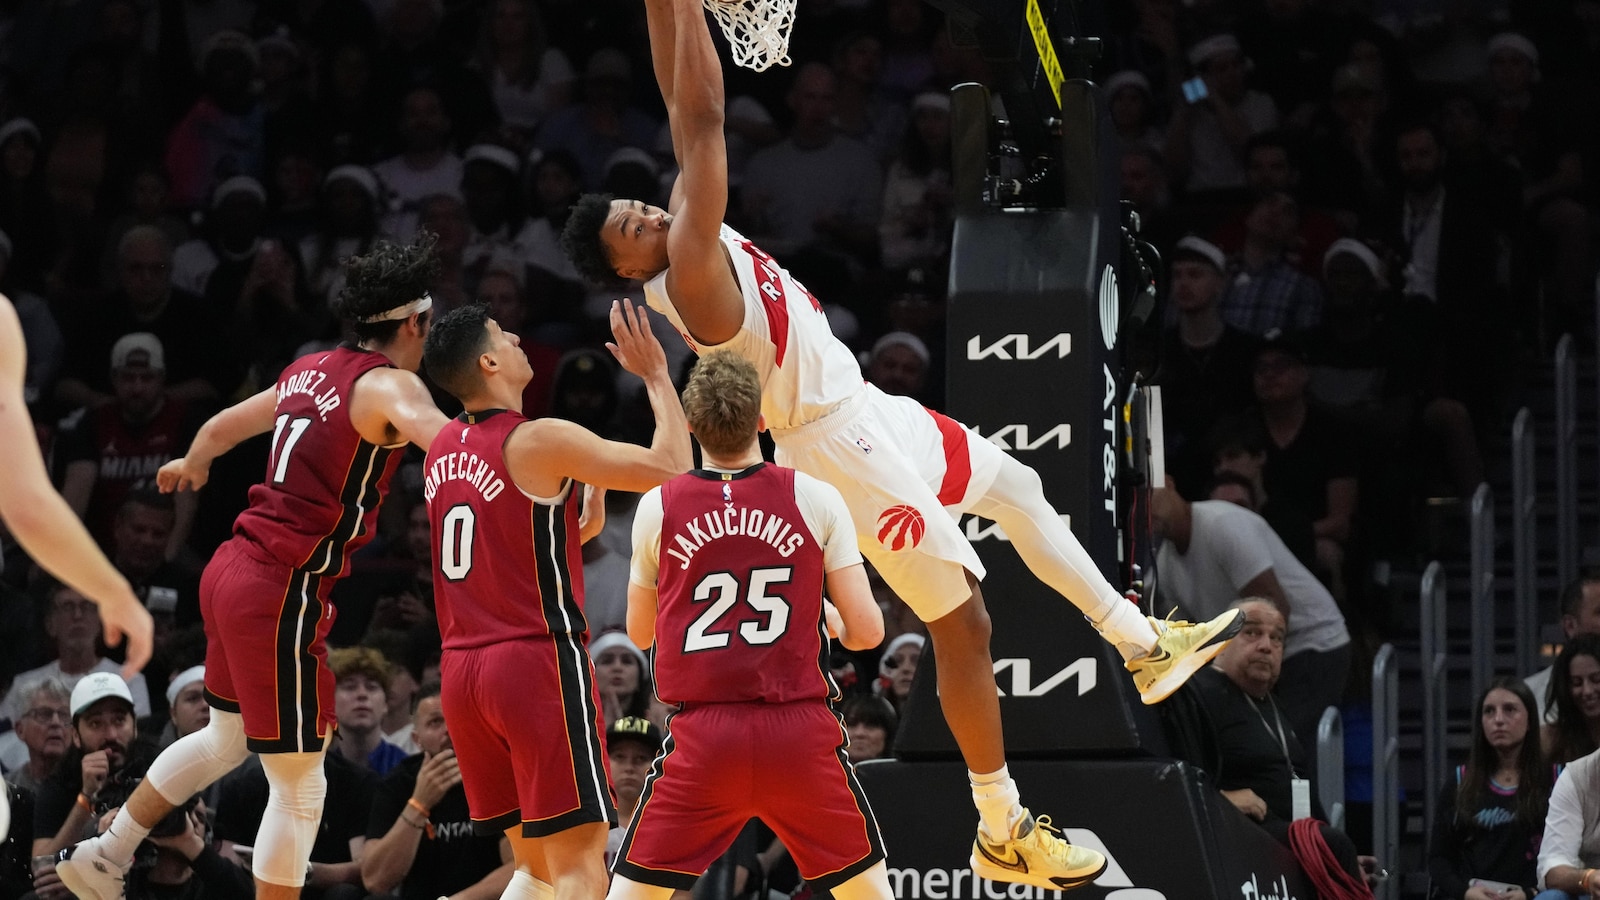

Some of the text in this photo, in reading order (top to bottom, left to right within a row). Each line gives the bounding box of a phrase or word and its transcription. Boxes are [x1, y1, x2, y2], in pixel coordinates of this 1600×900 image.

[967, 333, 1071, 360] KIA
[275, 370, 341, 422] AQUEZ JR.
[271, 412, 312, 484] 11
[1103, 362, 1117, 528] AT&T
[441, 504, 475, 582] 0
[667, 502, 805, 570] JAKUČIONIS
[682, 566, 793, 655] 25
